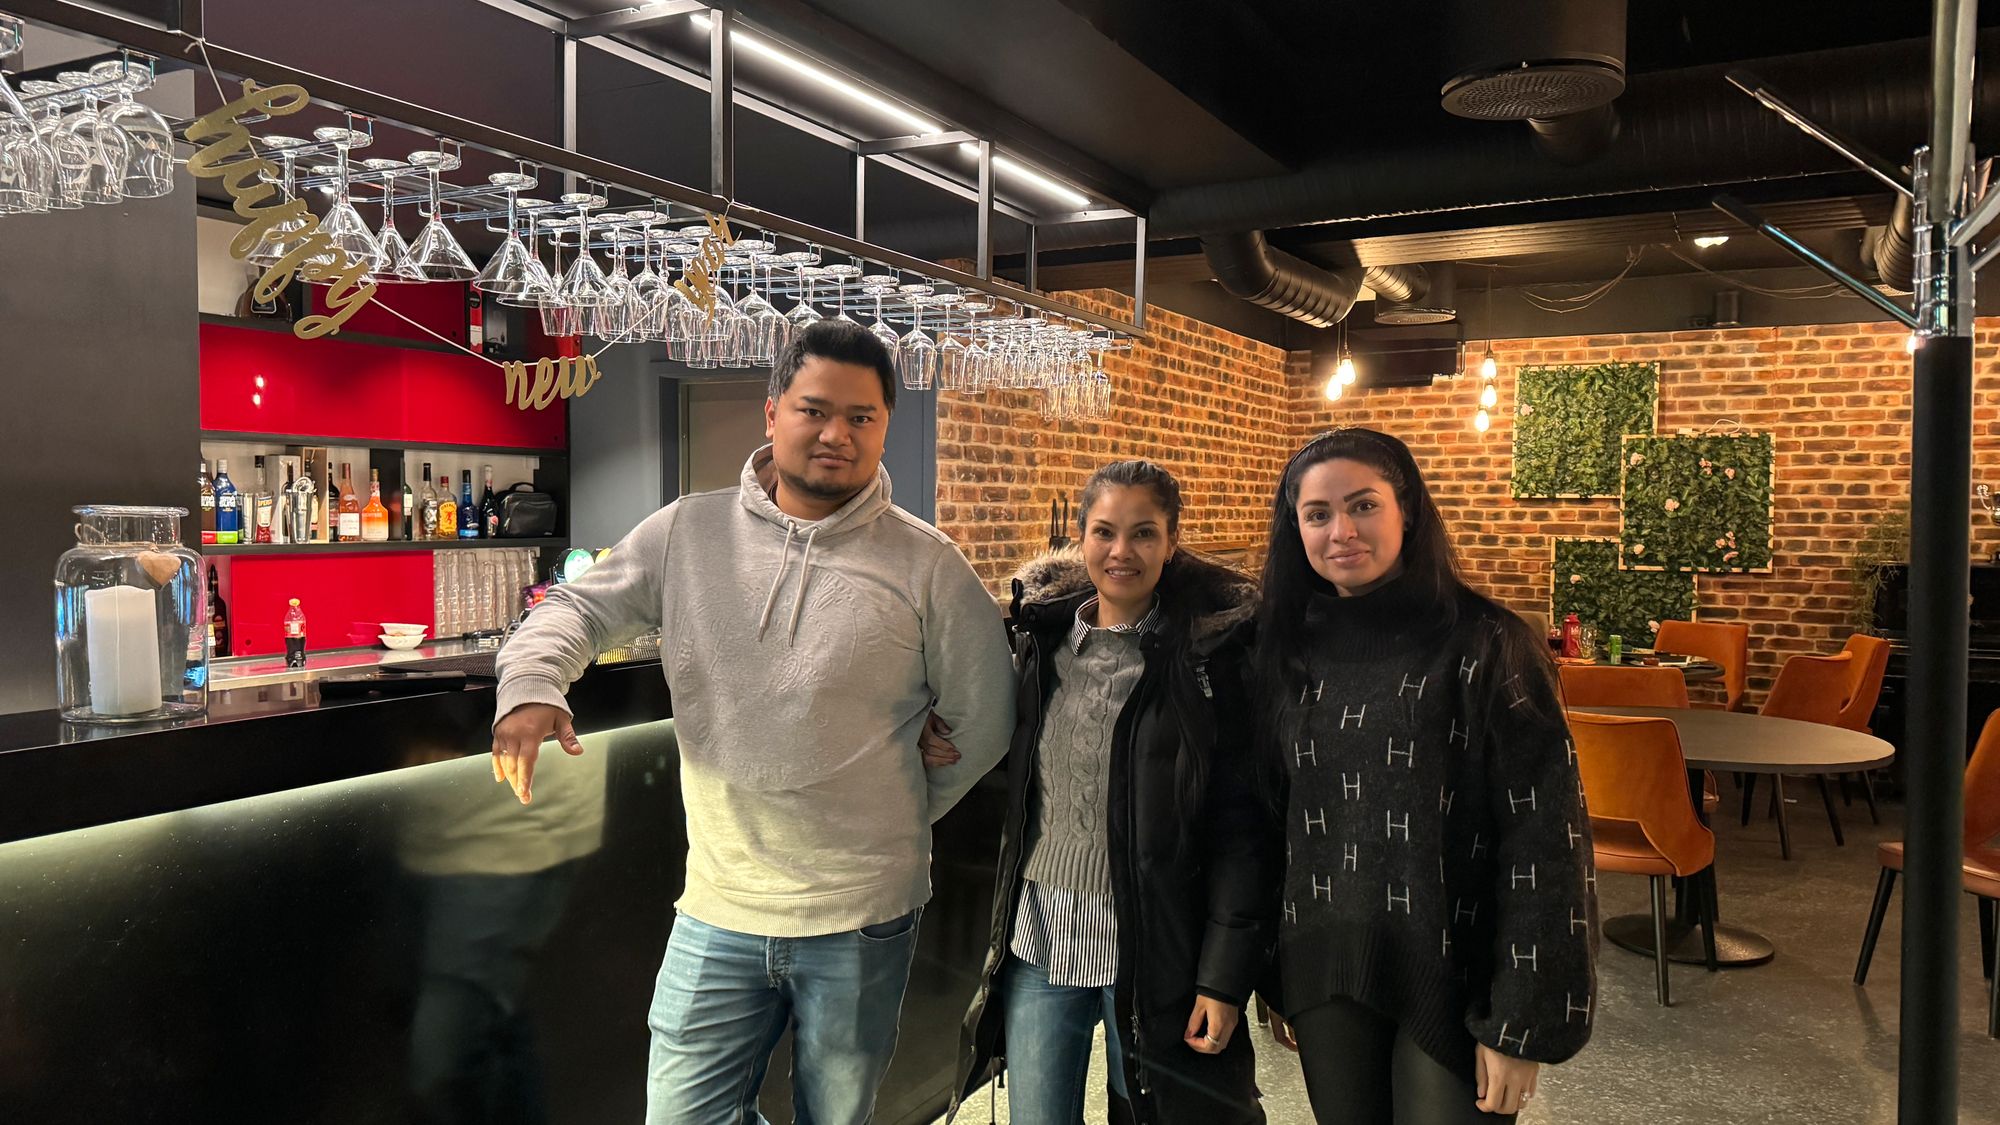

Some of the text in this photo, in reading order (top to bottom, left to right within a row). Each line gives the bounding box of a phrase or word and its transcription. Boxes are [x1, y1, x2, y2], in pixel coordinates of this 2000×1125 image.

[184, 78, 377, 339] happy
[502, 354, 601, 410] new
[1459, 656, 1477, 683] H
[1399, 673, 1426, 699] H
[1340, 704, 1366, 729] H
[1449, 719, 1468, 750] H
[1296, 740, 1317, 767] H
[1387, 737, 1413, 767] H
[1343, 772, 1359, 800] H
[1509, 786, 1536, 813] H
[1305, 808, 1326, 835] H
[1387, 810, 1408, 841] H
[1344, 843, 1356, 871] H
[1313, 874, 1331, 901] H
[1512, 864, 1535, 889] H
[1388, 884, 1410, 913] H
[1512, 944, 1537, 970] H
[1566, 993, 1590, 1024] H
[1498, 1023, 1529, 1055] H
